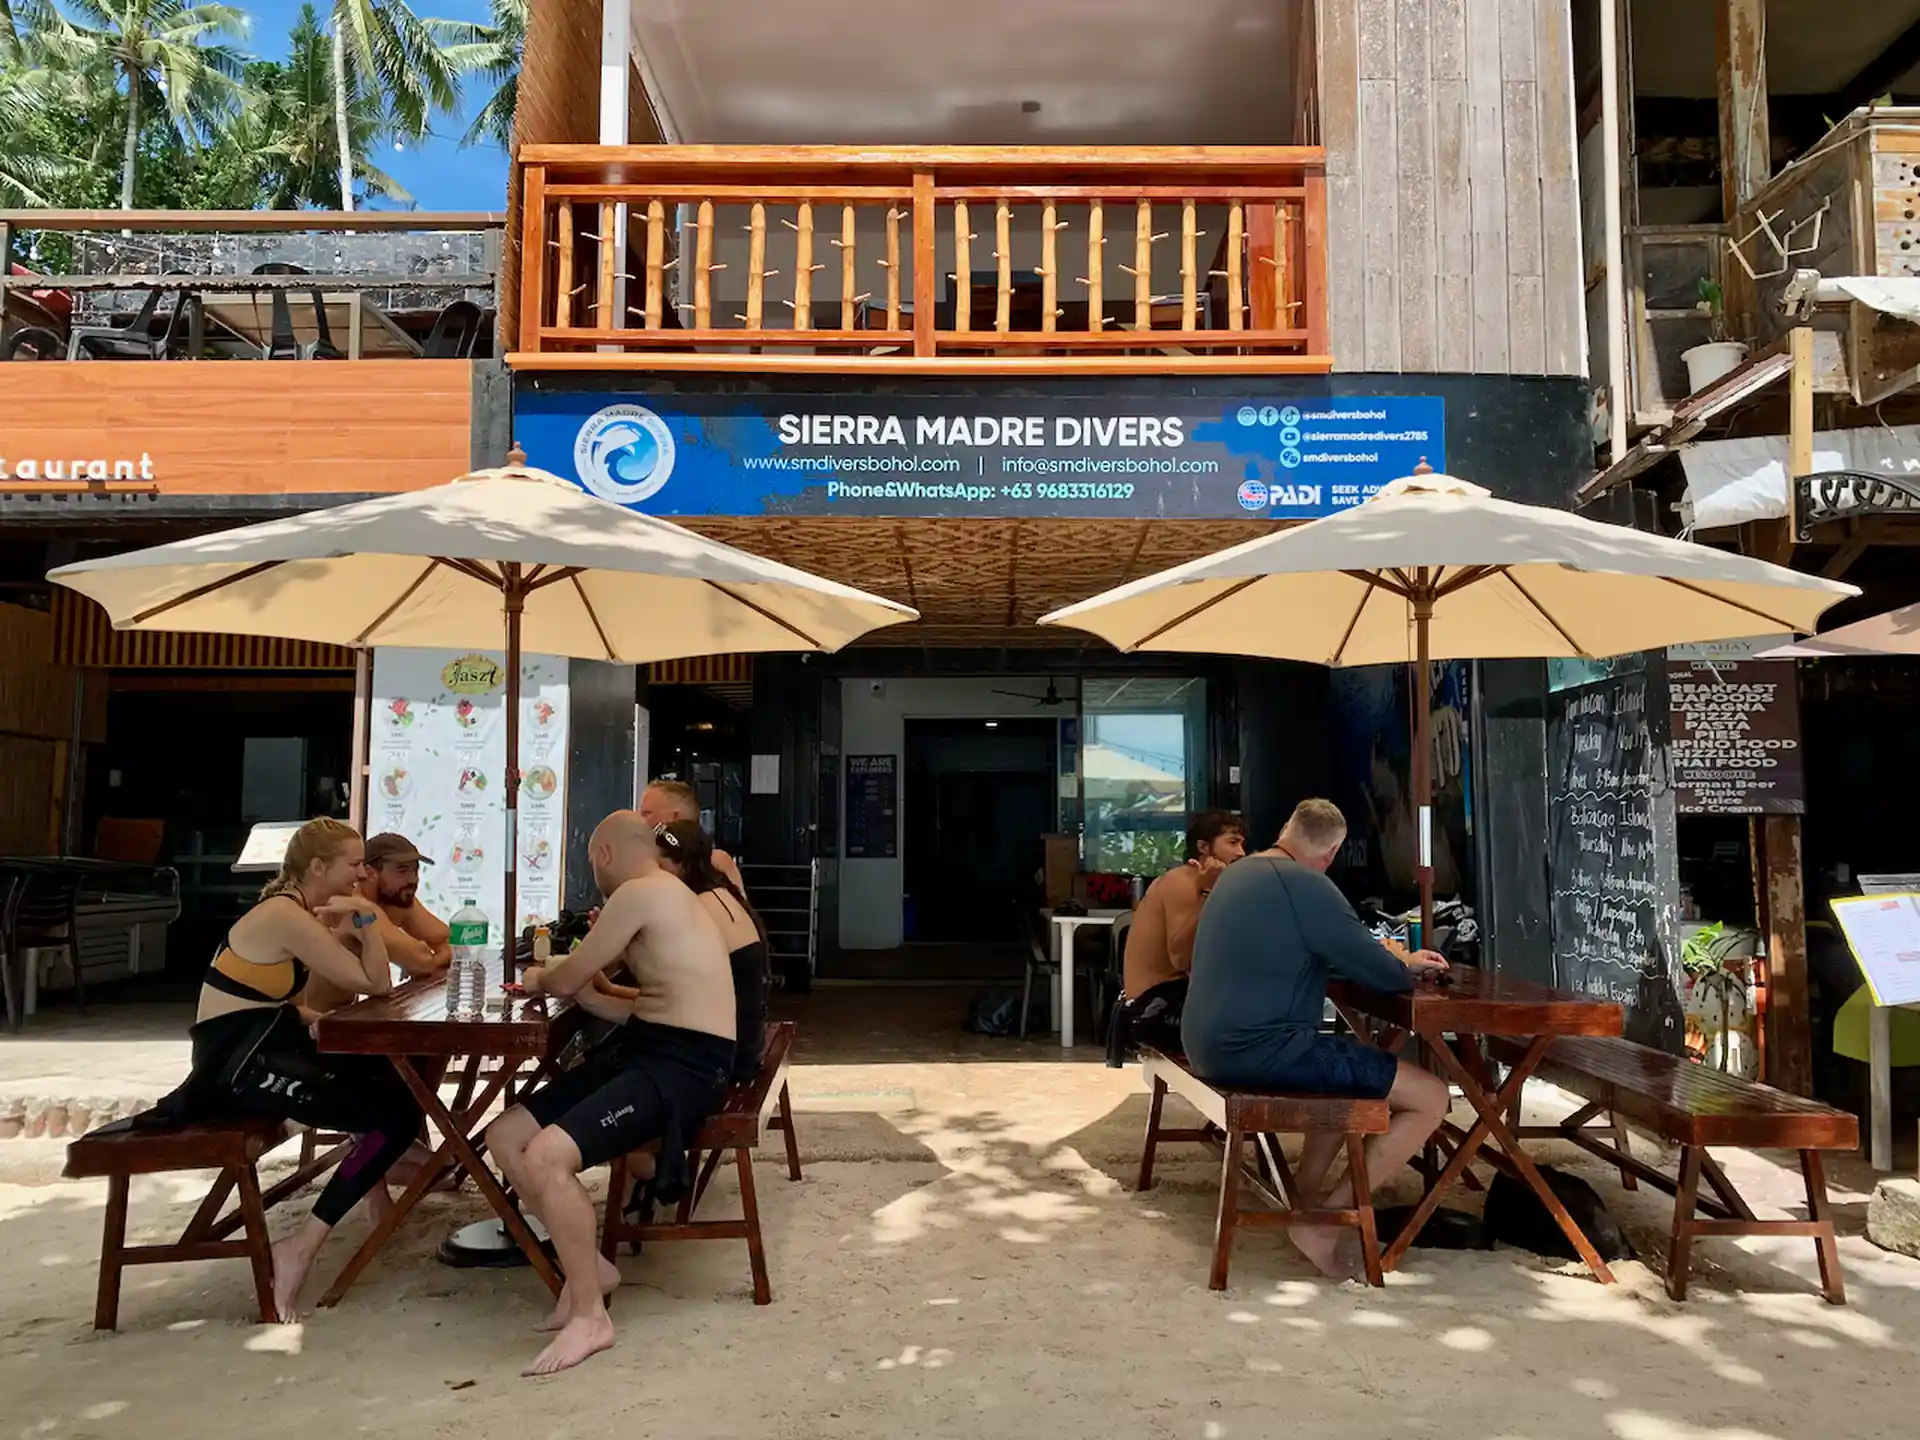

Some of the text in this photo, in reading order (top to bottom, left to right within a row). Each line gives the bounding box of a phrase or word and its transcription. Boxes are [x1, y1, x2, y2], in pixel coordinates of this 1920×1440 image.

[779, 415, 1184, 448] SIERRA MADRE DIVERS
[1302, 452, 1378, 464] smdiversbohol
[743, 454, 960, 473] www.smdiversbohol.com
[1002, 456, 1219, 475] info@smdiversbohol.com
[827, 481, 1135, 502] Phone&WhatsApp: +63 9683316129
[1331, 485, 1359, 494] SEEK
[1269, 485, 1321, 505] PADI
[1331, 496, 1359, 505] SAVE
[1669, 683, 1778, 693] REAKFAST
[1671, 693, 1775, 703] EAFOODS
[1669, 703, 1766, 712] LASAGNA
[1686, 712, 1749, 721] PIZZA
[1685, 721, 1751, 730] PASTA
[1694, 730, 1742, 740] PIES
[1672, 739, 1797, 749] IPINO FOOD
[1672, 749, 1767, 758] SIZZLING
[1674, 758, 1778, 768] HAI FOOD
[1673, 780, 1776, 789] erman Beer
[1694, 788, 1747, 797] Shake
[1698, 796, 1743, 805] Juice
[1680, 804, 1764, 813] Ice Cream
